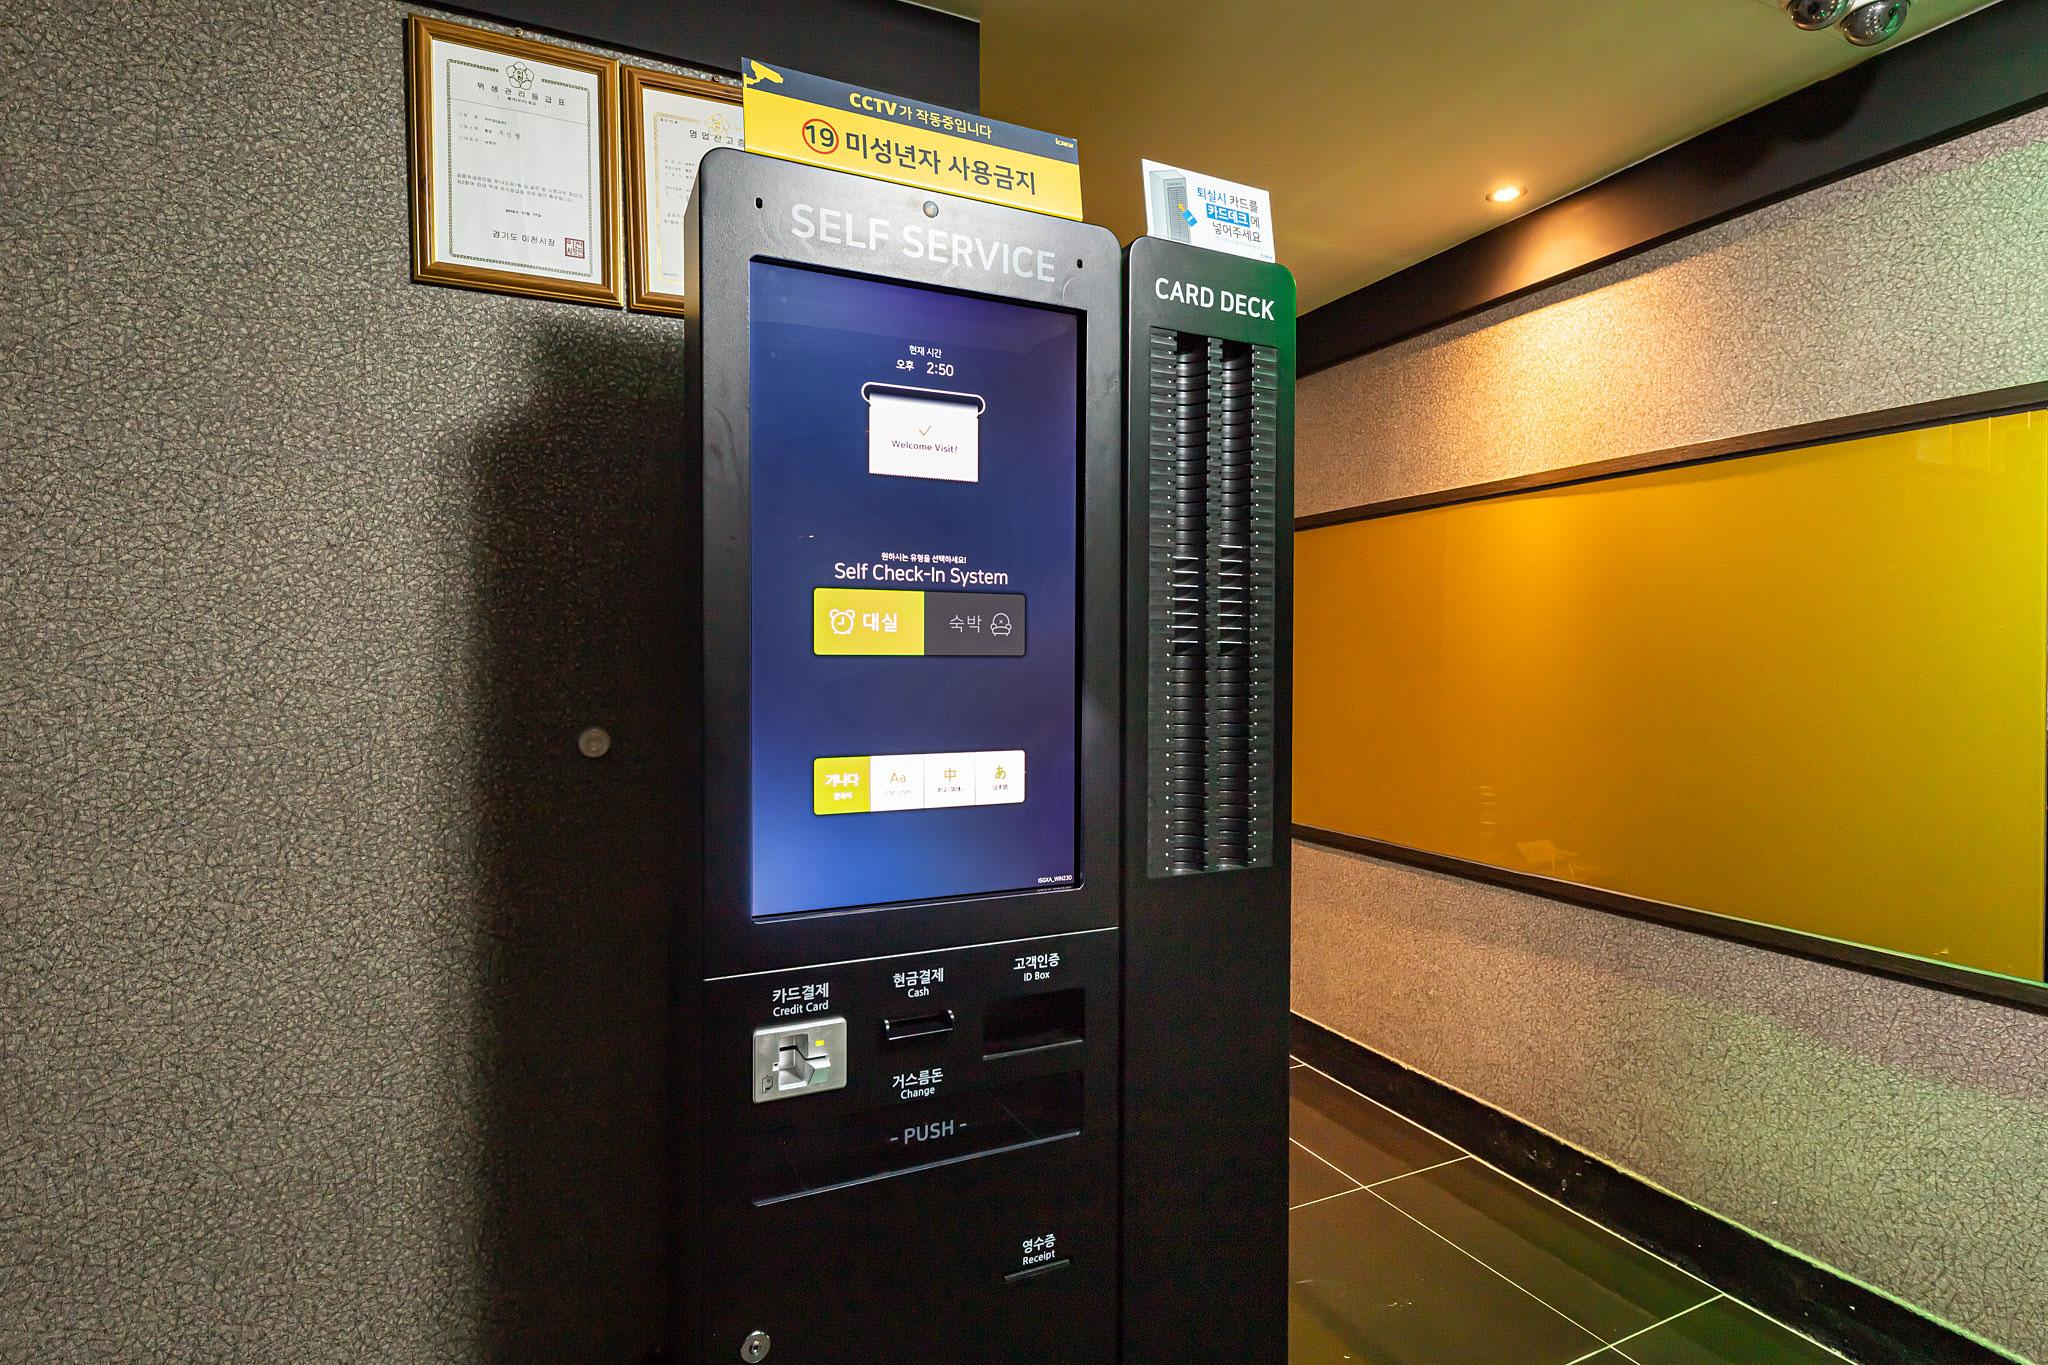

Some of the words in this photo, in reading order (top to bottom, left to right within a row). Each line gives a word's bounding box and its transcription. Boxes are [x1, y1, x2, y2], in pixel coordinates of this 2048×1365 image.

[849, 93, 913, 121] CCTV가
[916, 108, 992, 140] 작동중입니다
[805, 123, 835, 149] 19
[846, 131, 941, 175] 미성년자
[948, 156, 1036, 196] 사용금지
[1196, 187, 1227, 206] 퇴실시
[1229, 195, 1259, 213] 카드를
[492, 230, 518, 241] 경기도
[521, 234, 555, 247] 이천시장
[1213, 221, 1262, 243] 넣어주세요
[791, 203, 891, 251] SELF
[902, 224, 1056, 284] SERVICE
[1155, 277, 1215, 309] CARD
[1220, 290, 1275, 321] DECK
[908, 345, 925, 357] 현재
[926, 347, 942, 359] 시간
[896, 359, 915, 372] 오후
[926, 361, 954, 376] 2:50
[891, 440, 932, 451] Welcome
[934, 443, 958, 454] Visit!
[880, 552, 909, 562] 원하시는
[834, 562, 868, 580] Self
[872, 564, 946, 583] Check-In
[950, 567, 1008, 587] System
[862, 612, 898, 633] 대실
[949, 614, 983, 633] 숙박
[889, 772, 906, 784] Aa
[943, 767, 956, 782] 中
[994, 765, 1007, 780] あ
[1013, 952, 1060, 971] 고객인증
[893, 967, 944, 988] 현금결제
[1023, 972, 1033, 982] ID
[1034, 970, 1050, 981] Box
[772, 982, 830, 1004] 카드결제
[908, 986, 930, 998] Cash
[773, 1004, 804, 1017] Credit
[806, 1000, 829, 1014] Card
[892, 1067, 944, 1090] 거스름돈
[900, 1086, 936, 1100] Change
[1022, 1233, 1056, 1254] 영수증
[1022, 1250, 1056, 1265] Receipt
